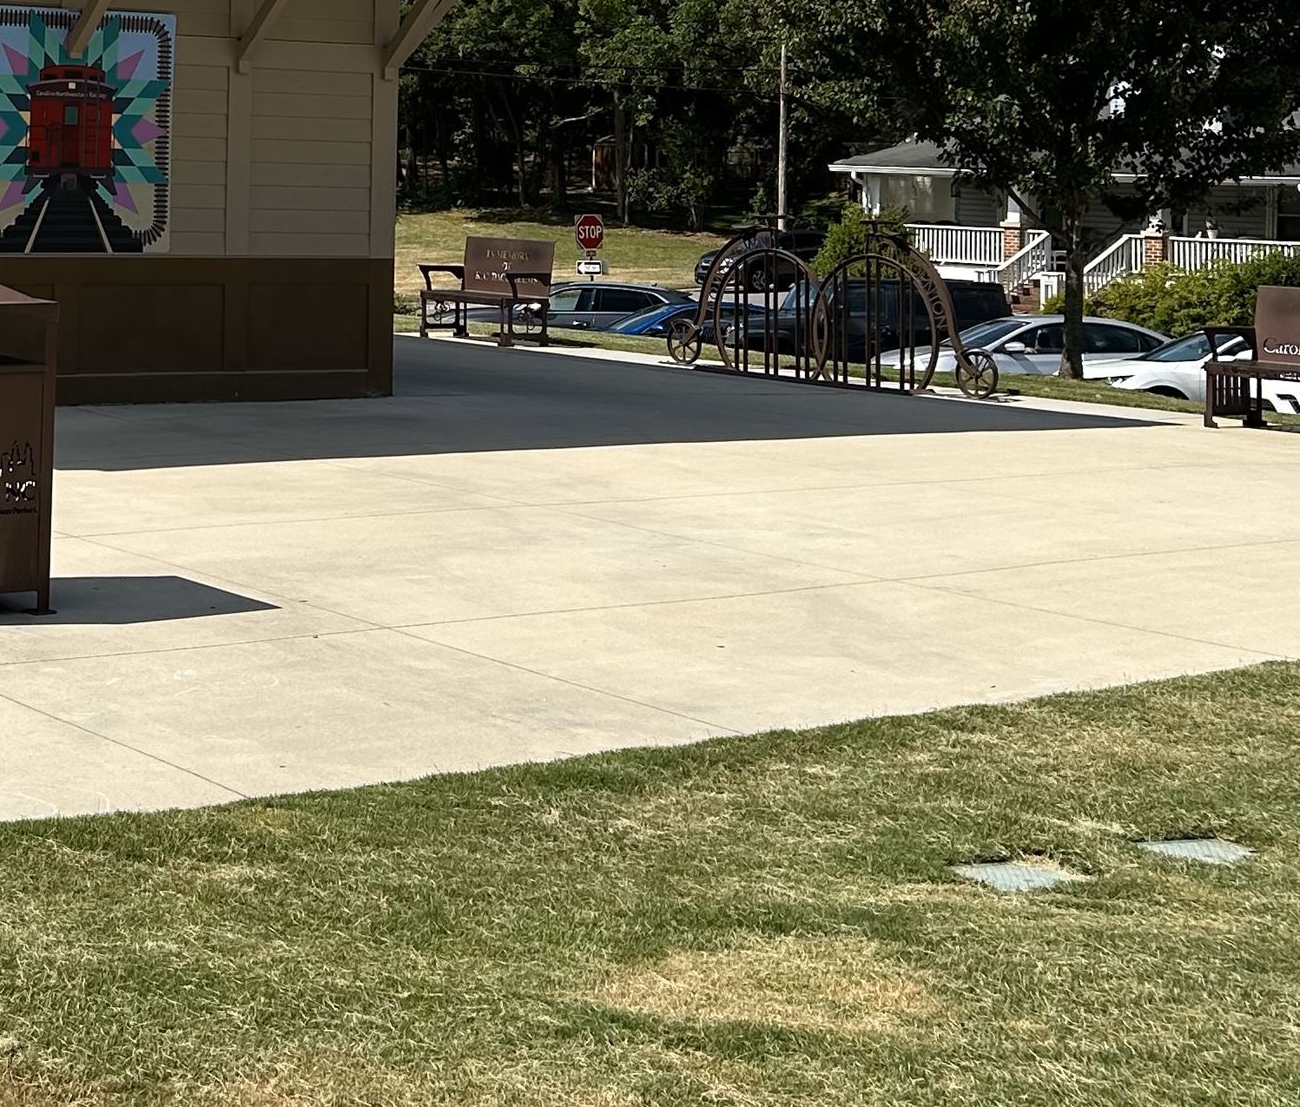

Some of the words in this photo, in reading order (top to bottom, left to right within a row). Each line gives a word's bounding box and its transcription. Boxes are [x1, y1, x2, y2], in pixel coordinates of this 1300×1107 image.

[578, 225, 602, 239] STOP
[1263, 336, 1300, 356] Caro
[4, 480, 36, 503] NC
